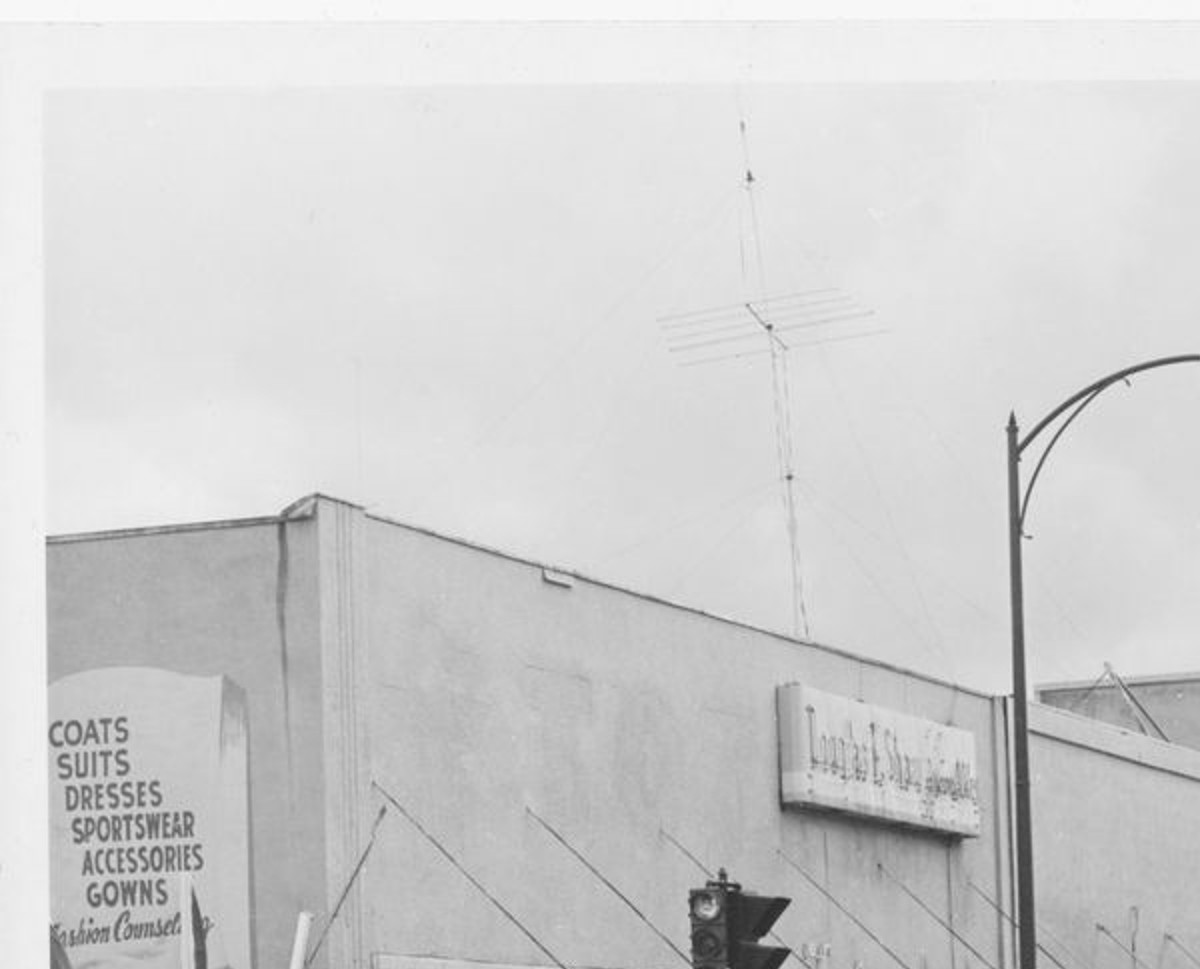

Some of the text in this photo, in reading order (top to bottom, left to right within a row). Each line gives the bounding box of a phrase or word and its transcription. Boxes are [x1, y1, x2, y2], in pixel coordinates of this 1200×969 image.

[48, 717, 129, 748] COATS
[56, 749, 131, 780] SUITS
[65, 780, 163, 812] DRESSES
[71, 811, 195, 844] SPORTSWEAR
[82, 844, 204, 877] ACCESSORIES
[86, 879, 169, 909] GOWNS
